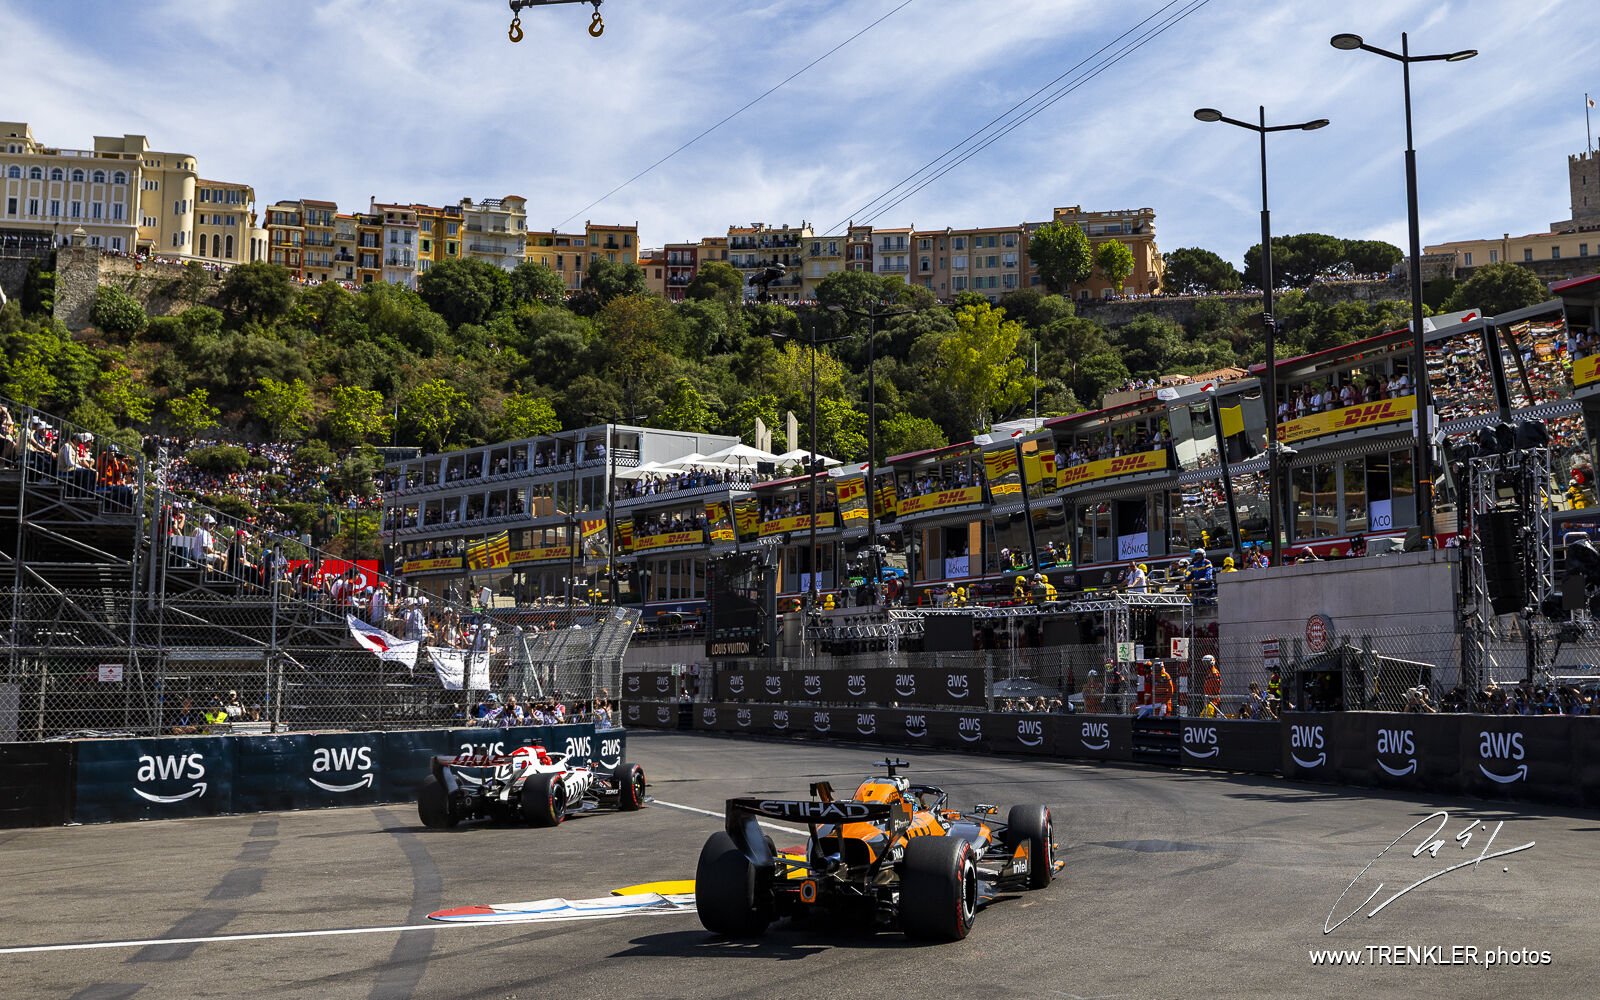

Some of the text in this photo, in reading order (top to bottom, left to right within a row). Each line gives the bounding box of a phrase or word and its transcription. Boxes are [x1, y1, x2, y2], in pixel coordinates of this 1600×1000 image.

[1344, 402, 1396, 426] DHL
[1064, 455, 1148, 481] DHL DHL
[902, 490, 967, 512] DHL DHL
[764, 521, 781, 532] DHL
[638, 533, 692, 547] DHL DHL
[545, 547, 568, 557] DHL
[431, 559, 453, 568] DHL
[711, 642, 750, 655] LOUIS VUITTON
[628, 676, 639, 685] aws
[657, 676, 669, 685] aws
[730, 676, 744, 686] aws
[766, 676, 781, 686] aws
[805, 676, 820, 686] aws
[848, 675, 865, 686] aws
[896, 675, 915, 686] aws
[948, 675, 968, 687] aws
[657, 707, 669, 715] aws
[704, 708, 716, 717] aws
[737, 709, 750, 718] aws
[774, 710, 788, 720] aws
[814, 712, 830, 723] aws
[858, 714, 875, 725] aws
[906, 715, 925, 727] aws
[960, 718, 980, 731] aws
[1018, 720, 1042, 734] aws
[1082, 722, 1109, 738] aws
[1184, 727, 1218, 744] aws
[1291, 725, 1324, 748] aws
[566, 736, 591, 757] aws
[601, 739, 620, 756] aws
[1377, 729, 1415, 755] aws
[1480, 731, 1525, 760] aws
[313, 746, 372, 772] aws
[137, 753, 205, 782] aws
[759, 800, 870, 819] ETIHAD
[1013, 860, 1028, 874] intel
